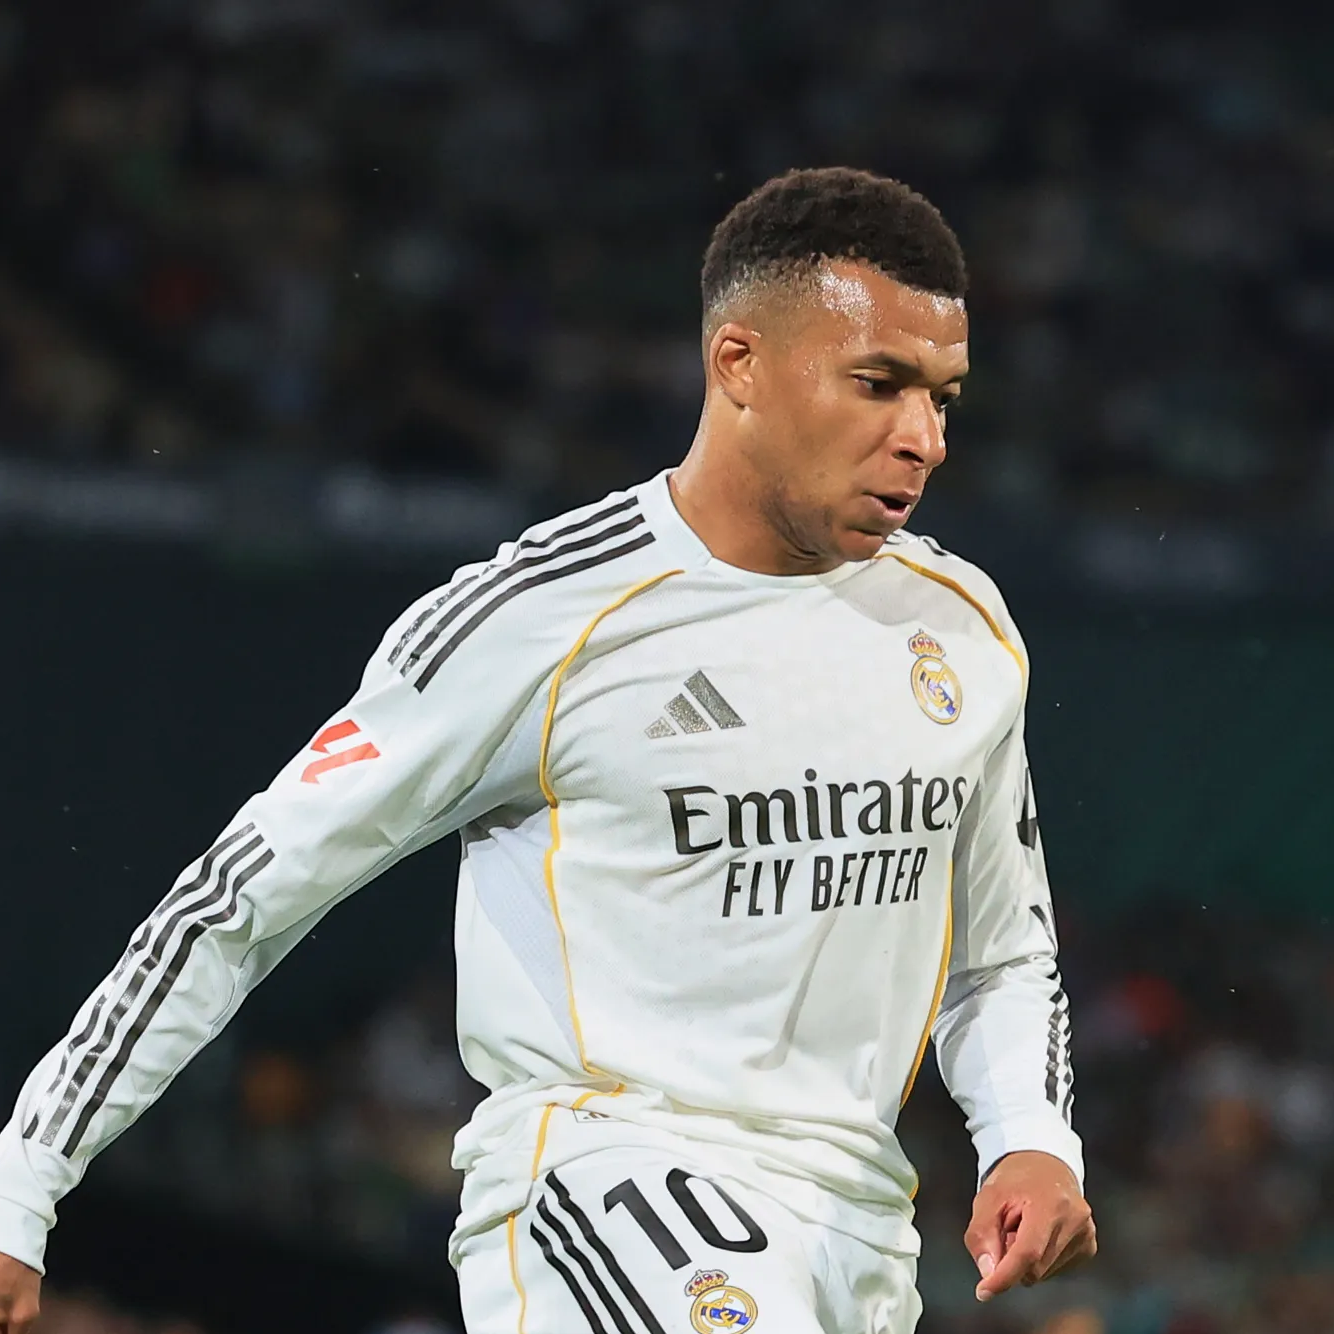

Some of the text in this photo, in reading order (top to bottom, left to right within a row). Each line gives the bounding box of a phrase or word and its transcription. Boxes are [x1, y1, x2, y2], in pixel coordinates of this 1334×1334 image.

[663, 767, 967, 855] Emirates
[722, 847, 928, 917] FLY BETTER
[603, 1168, 768, 1271] 10
